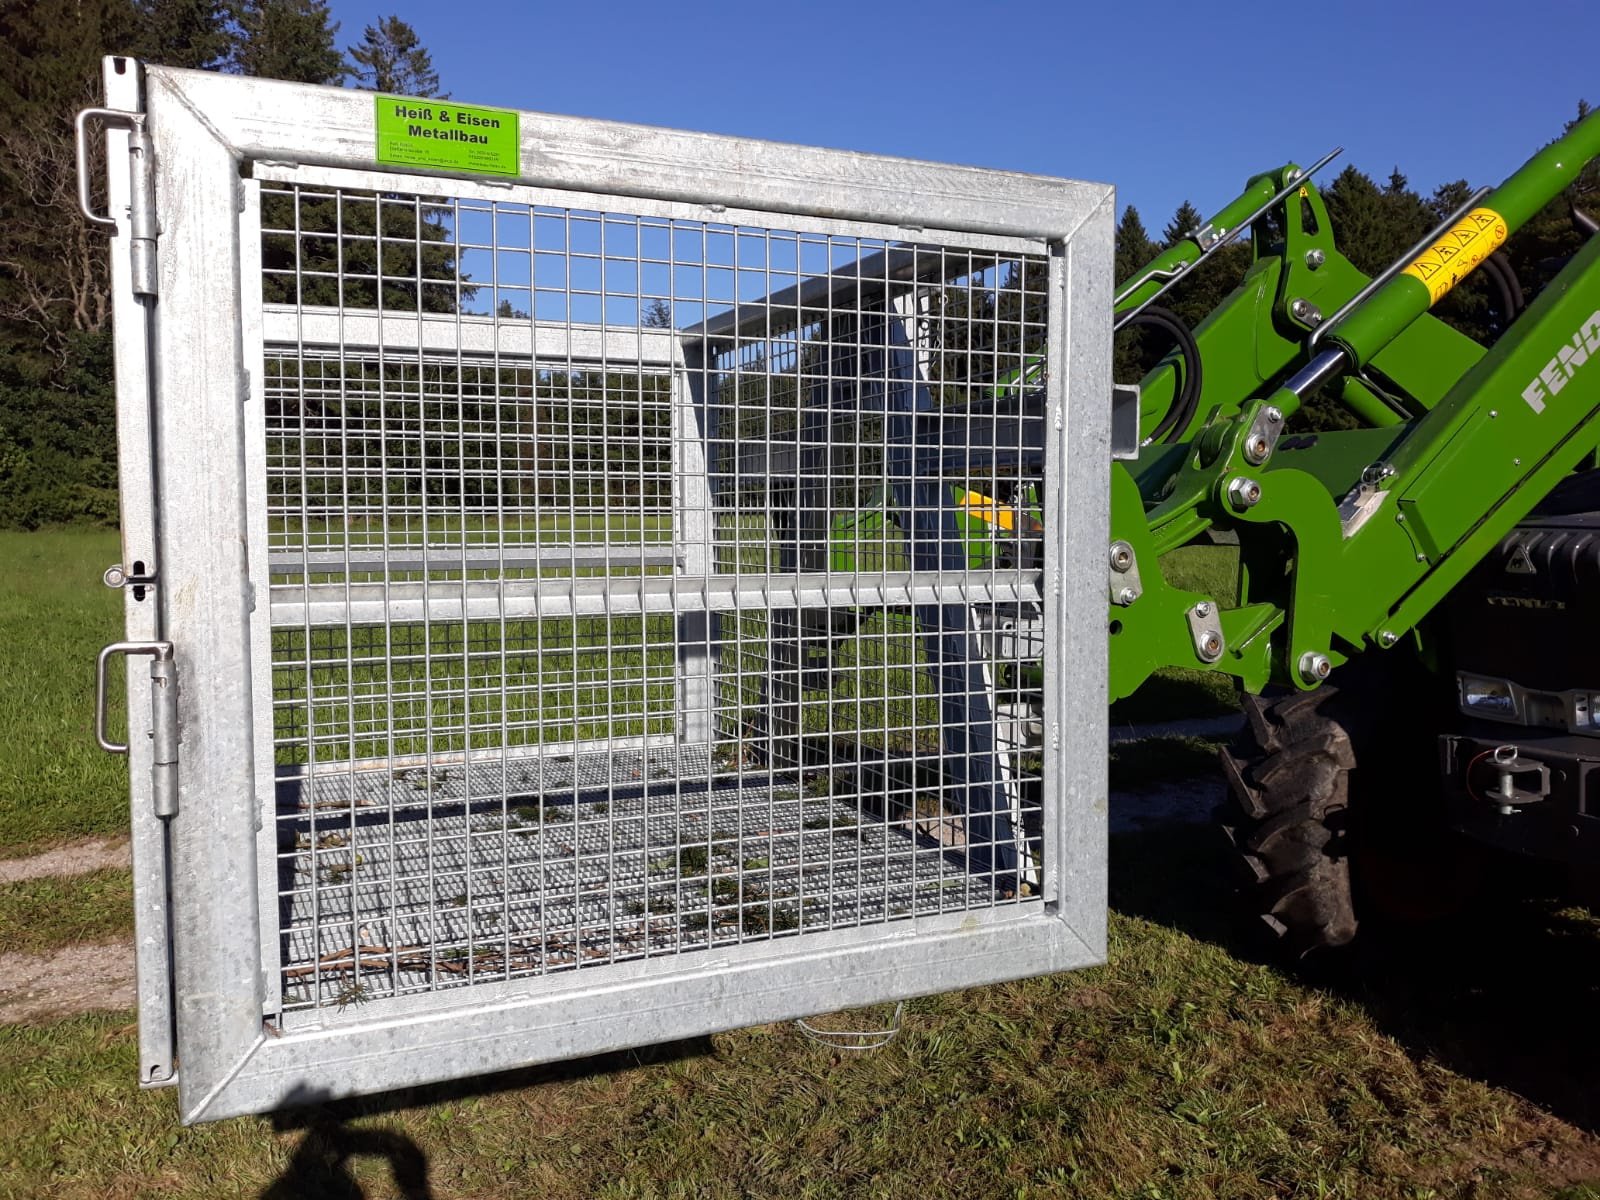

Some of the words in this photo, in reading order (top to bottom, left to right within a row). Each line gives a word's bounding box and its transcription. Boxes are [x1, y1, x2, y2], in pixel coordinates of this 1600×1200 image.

[395, 105, 433, 121] Heiß
[439, 110, 451, 122] &
[456, 112, 500, 129] Eisen
[408, 124, 488, 145] Metallbau
